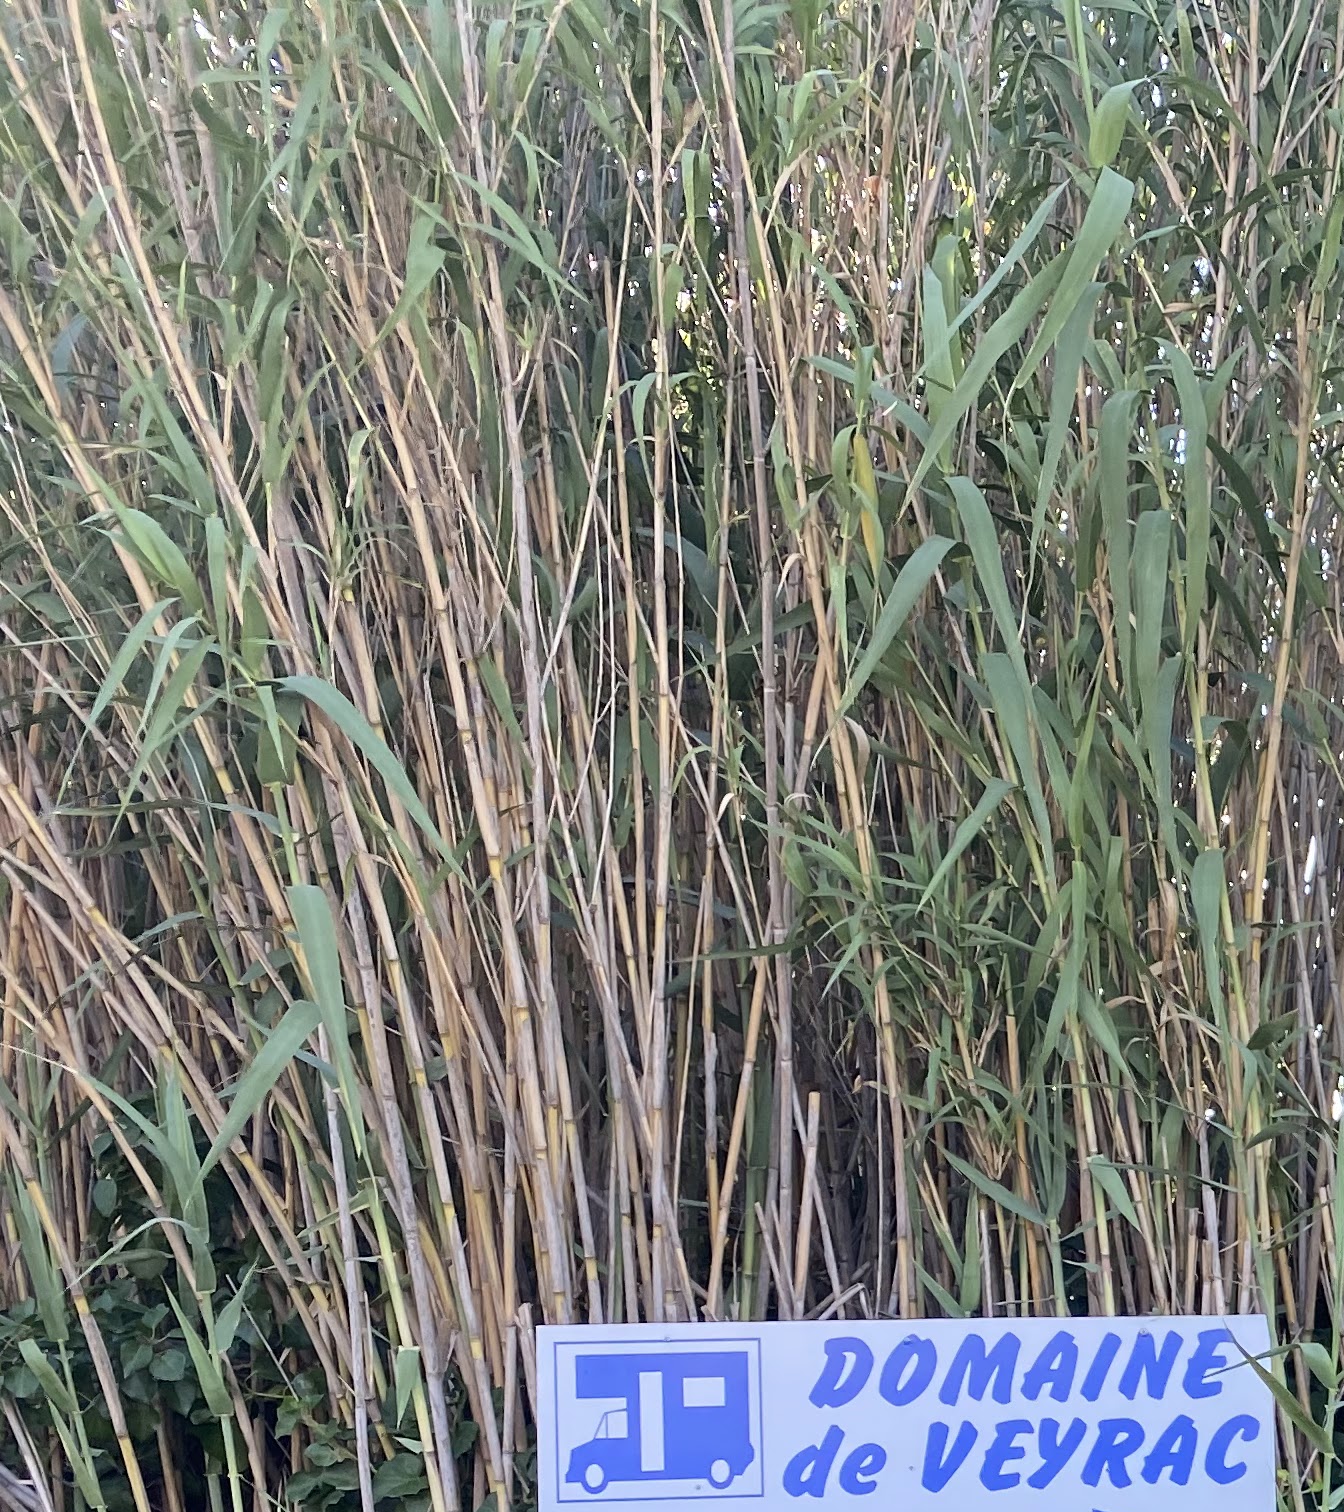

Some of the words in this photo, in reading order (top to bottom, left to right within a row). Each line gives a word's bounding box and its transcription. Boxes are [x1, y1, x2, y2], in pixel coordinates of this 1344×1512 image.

[808, 1328, 1230, 1408] DOMAINE
[782, 1424, 888, 1498] de
[920, 1413, 1260, 1494] VEYRAC
